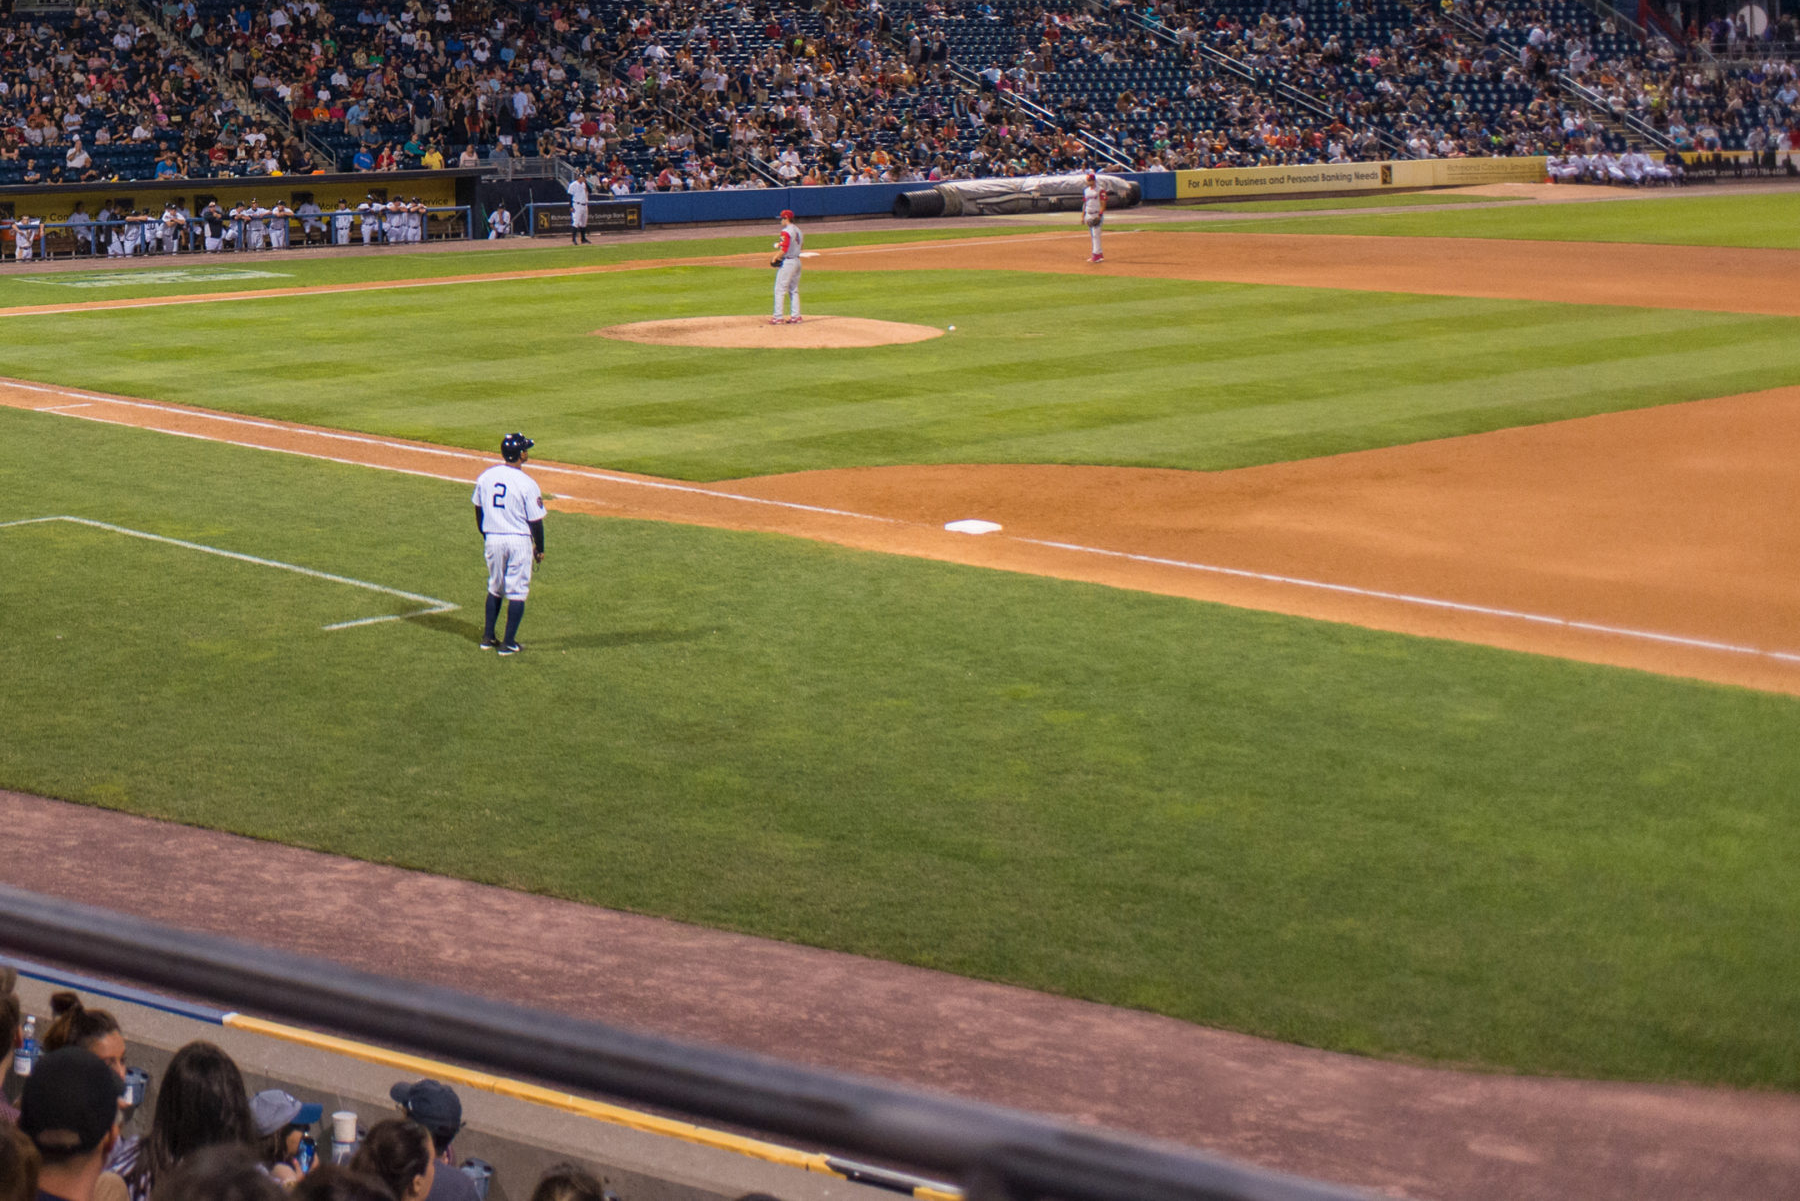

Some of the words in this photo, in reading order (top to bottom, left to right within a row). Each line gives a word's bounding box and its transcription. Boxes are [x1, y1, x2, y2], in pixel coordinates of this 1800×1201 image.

[1188, 180, 1200, 189] For
[1202, 178, 1213, 188] All
[1214, 178, 1232, 188] Your
[1234, 176, 1267, 187] Business
[1268, 175, 1285, 186] and
[1287, 173, 1320, 184] Personal
[1321, 172, 1353, 184] Banking
[1354, 171, 1379, 181] Needs
[493, 482, 507, 510] 2
